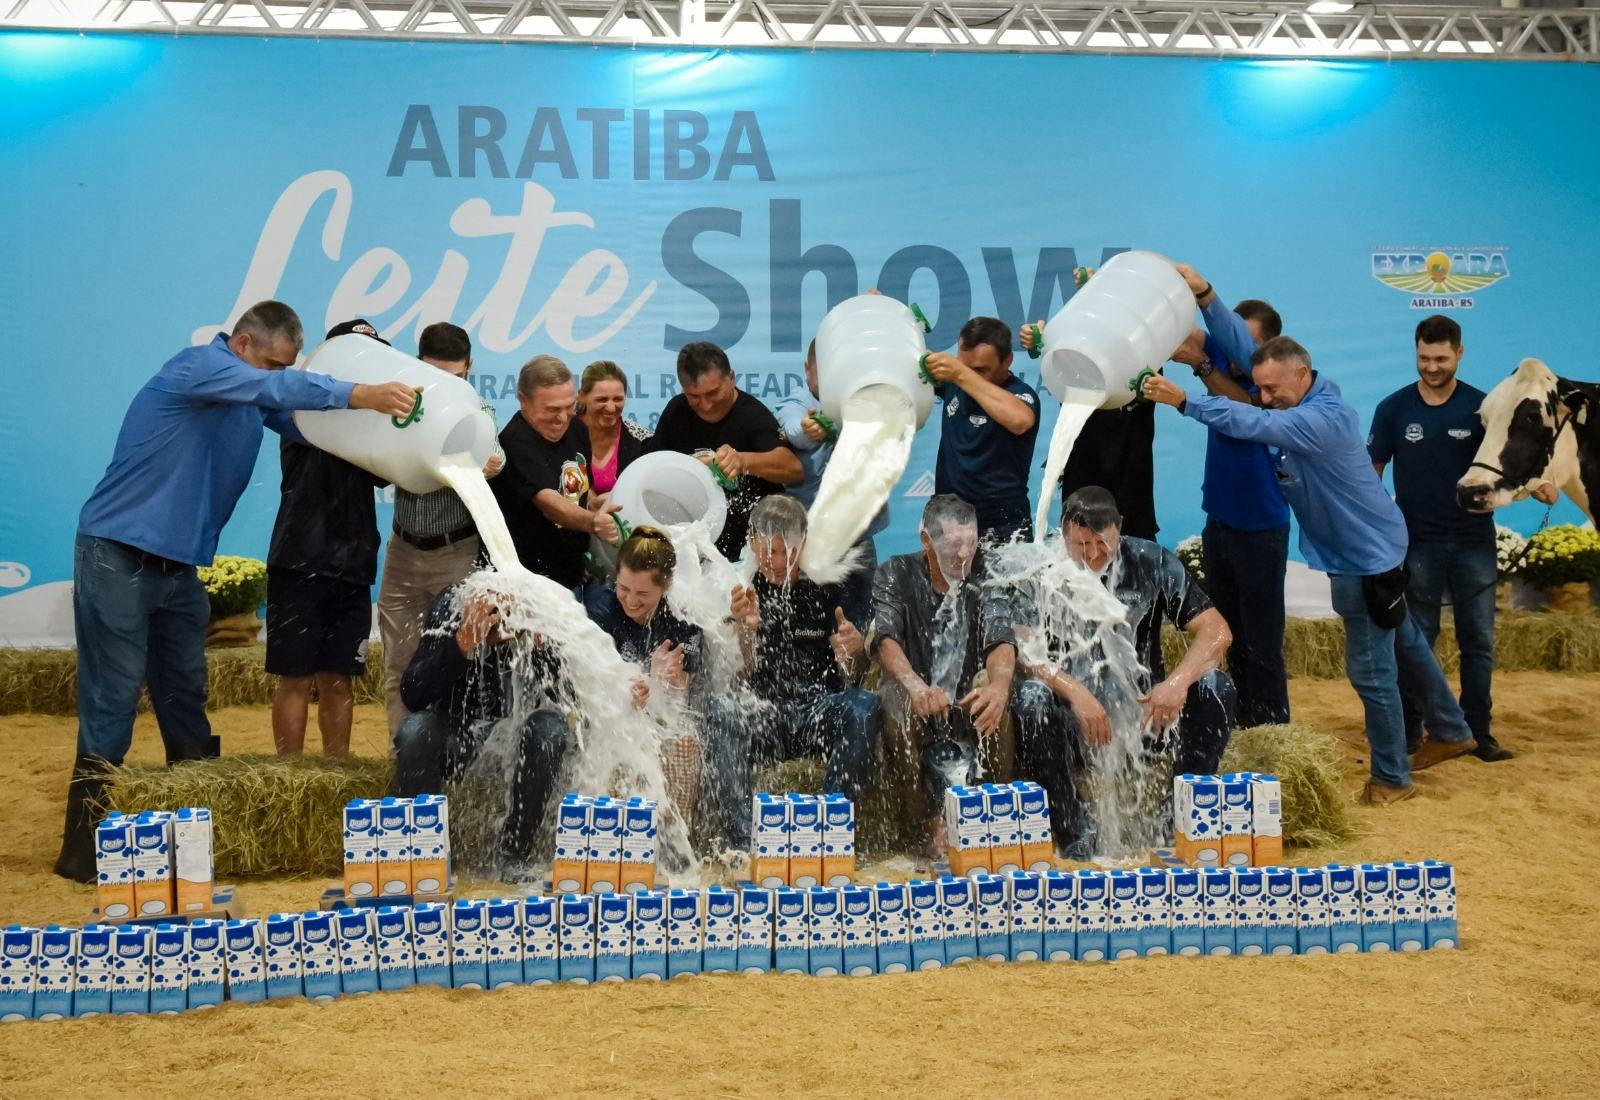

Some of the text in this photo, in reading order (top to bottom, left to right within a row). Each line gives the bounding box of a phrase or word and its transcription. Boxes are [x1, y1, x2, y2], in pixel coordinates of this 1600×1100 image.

[386, 104, 776, 182] ARATIBA
[191, 170, 1132, 353] Leite Show
[1411, 299, 1454, 308] ARATIBA
[1460, 299, 1473, 308] RS
